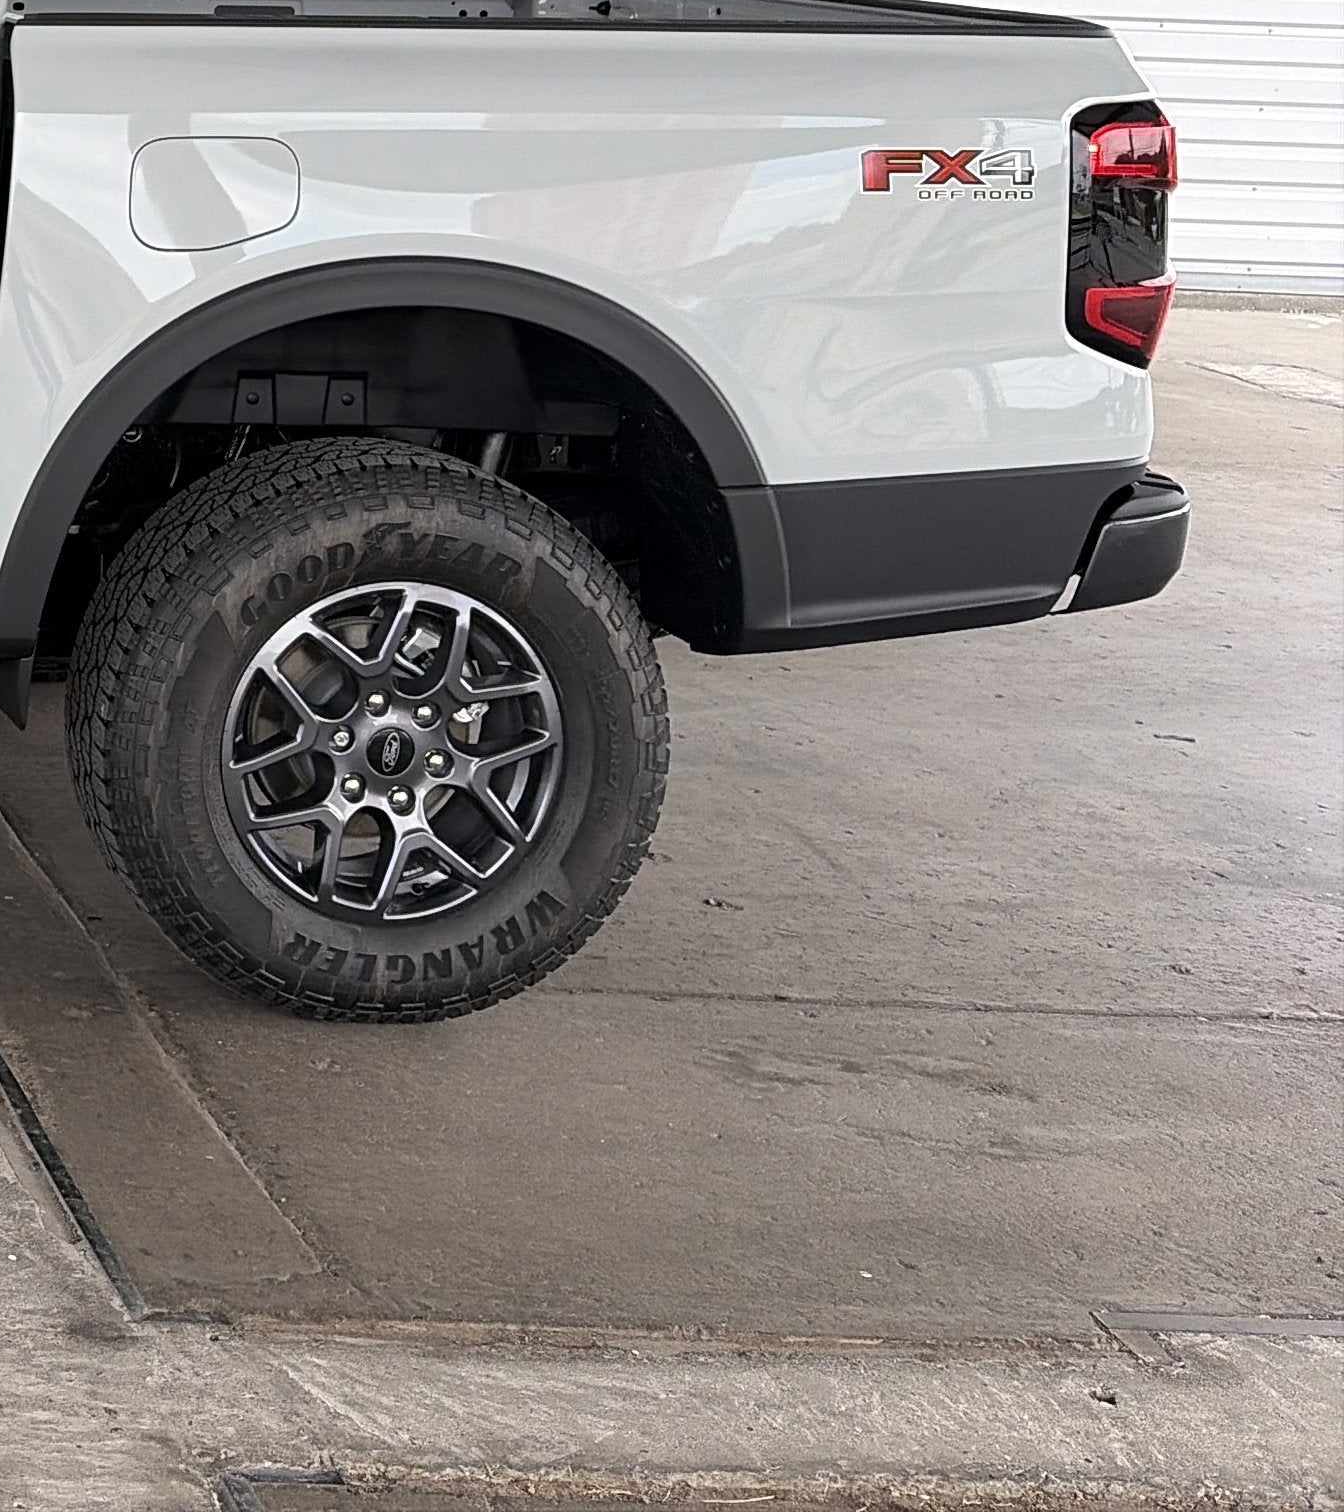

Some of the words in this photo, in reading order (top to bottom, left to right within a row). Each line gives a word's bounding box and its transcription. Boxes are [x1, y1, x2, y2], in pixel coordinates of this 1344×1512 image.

[860, 148, 1036, 194] FX4
[917, 189, 965, 201] OFF
[972, 189, 1034, 201] ROAD
[283, 889, 568, 985] WRANGLER
